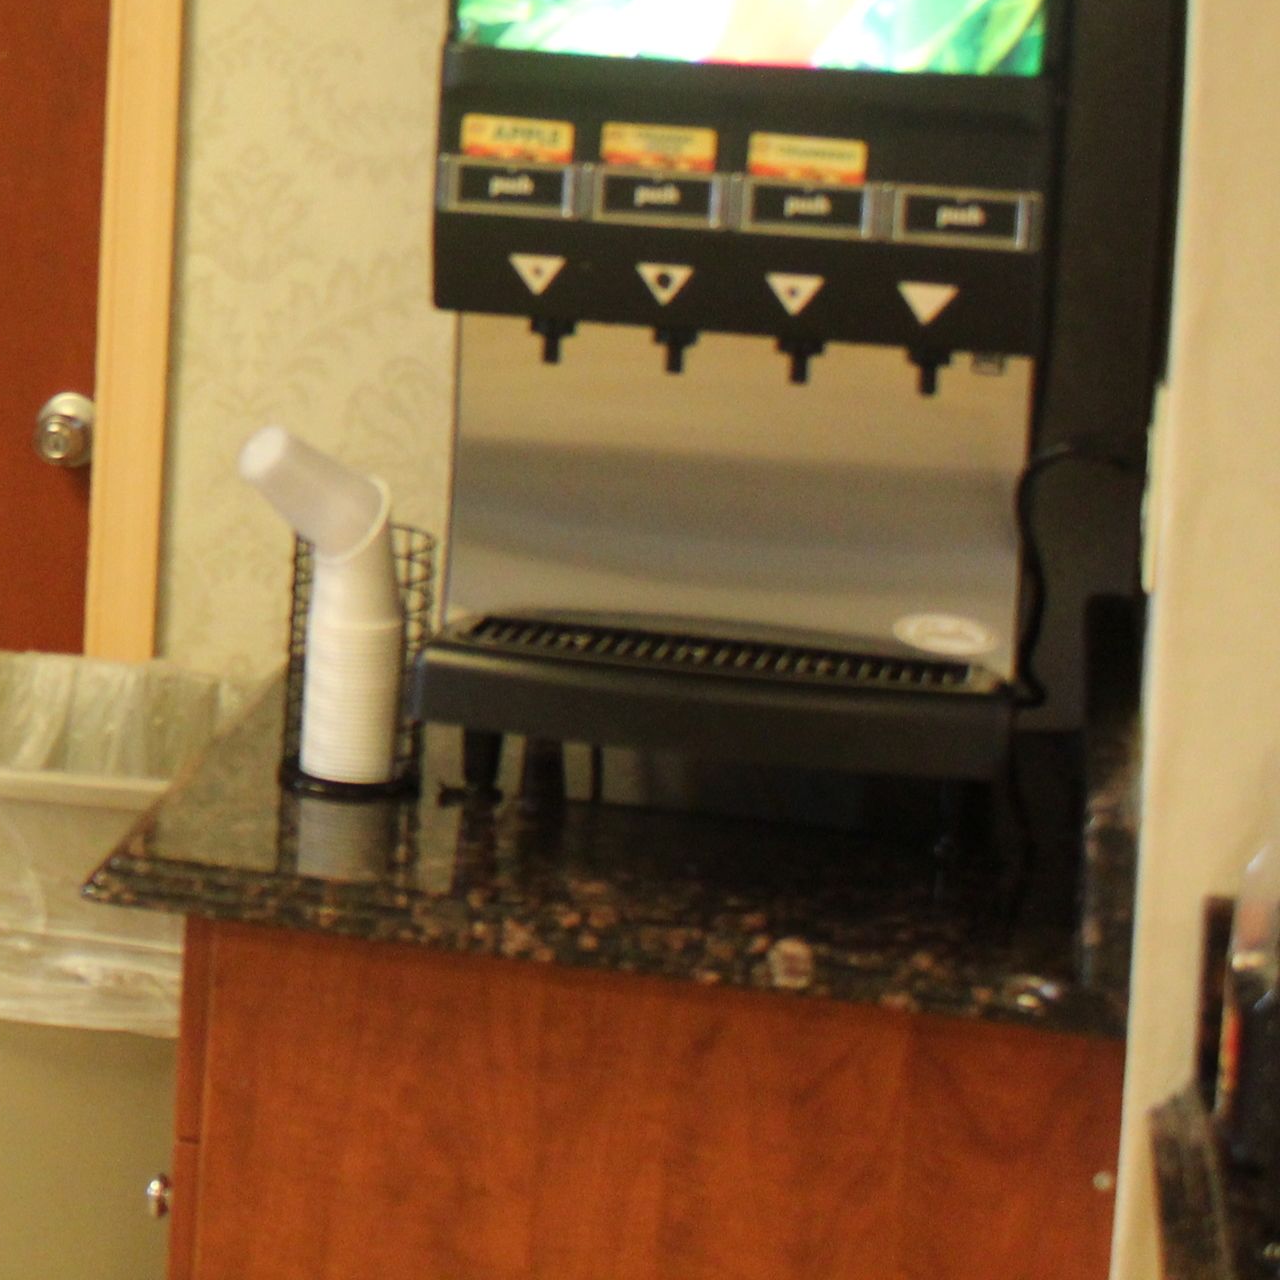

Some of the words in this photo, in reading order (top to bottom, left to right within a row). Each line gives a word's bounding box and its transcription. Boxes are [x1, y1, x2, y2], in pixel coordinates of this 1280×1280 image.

[489, 173, 535, 197] push
[634, 183, 681, 207] push
[783, 193, 831, 217] push
[936, 204, 985, 227] push
